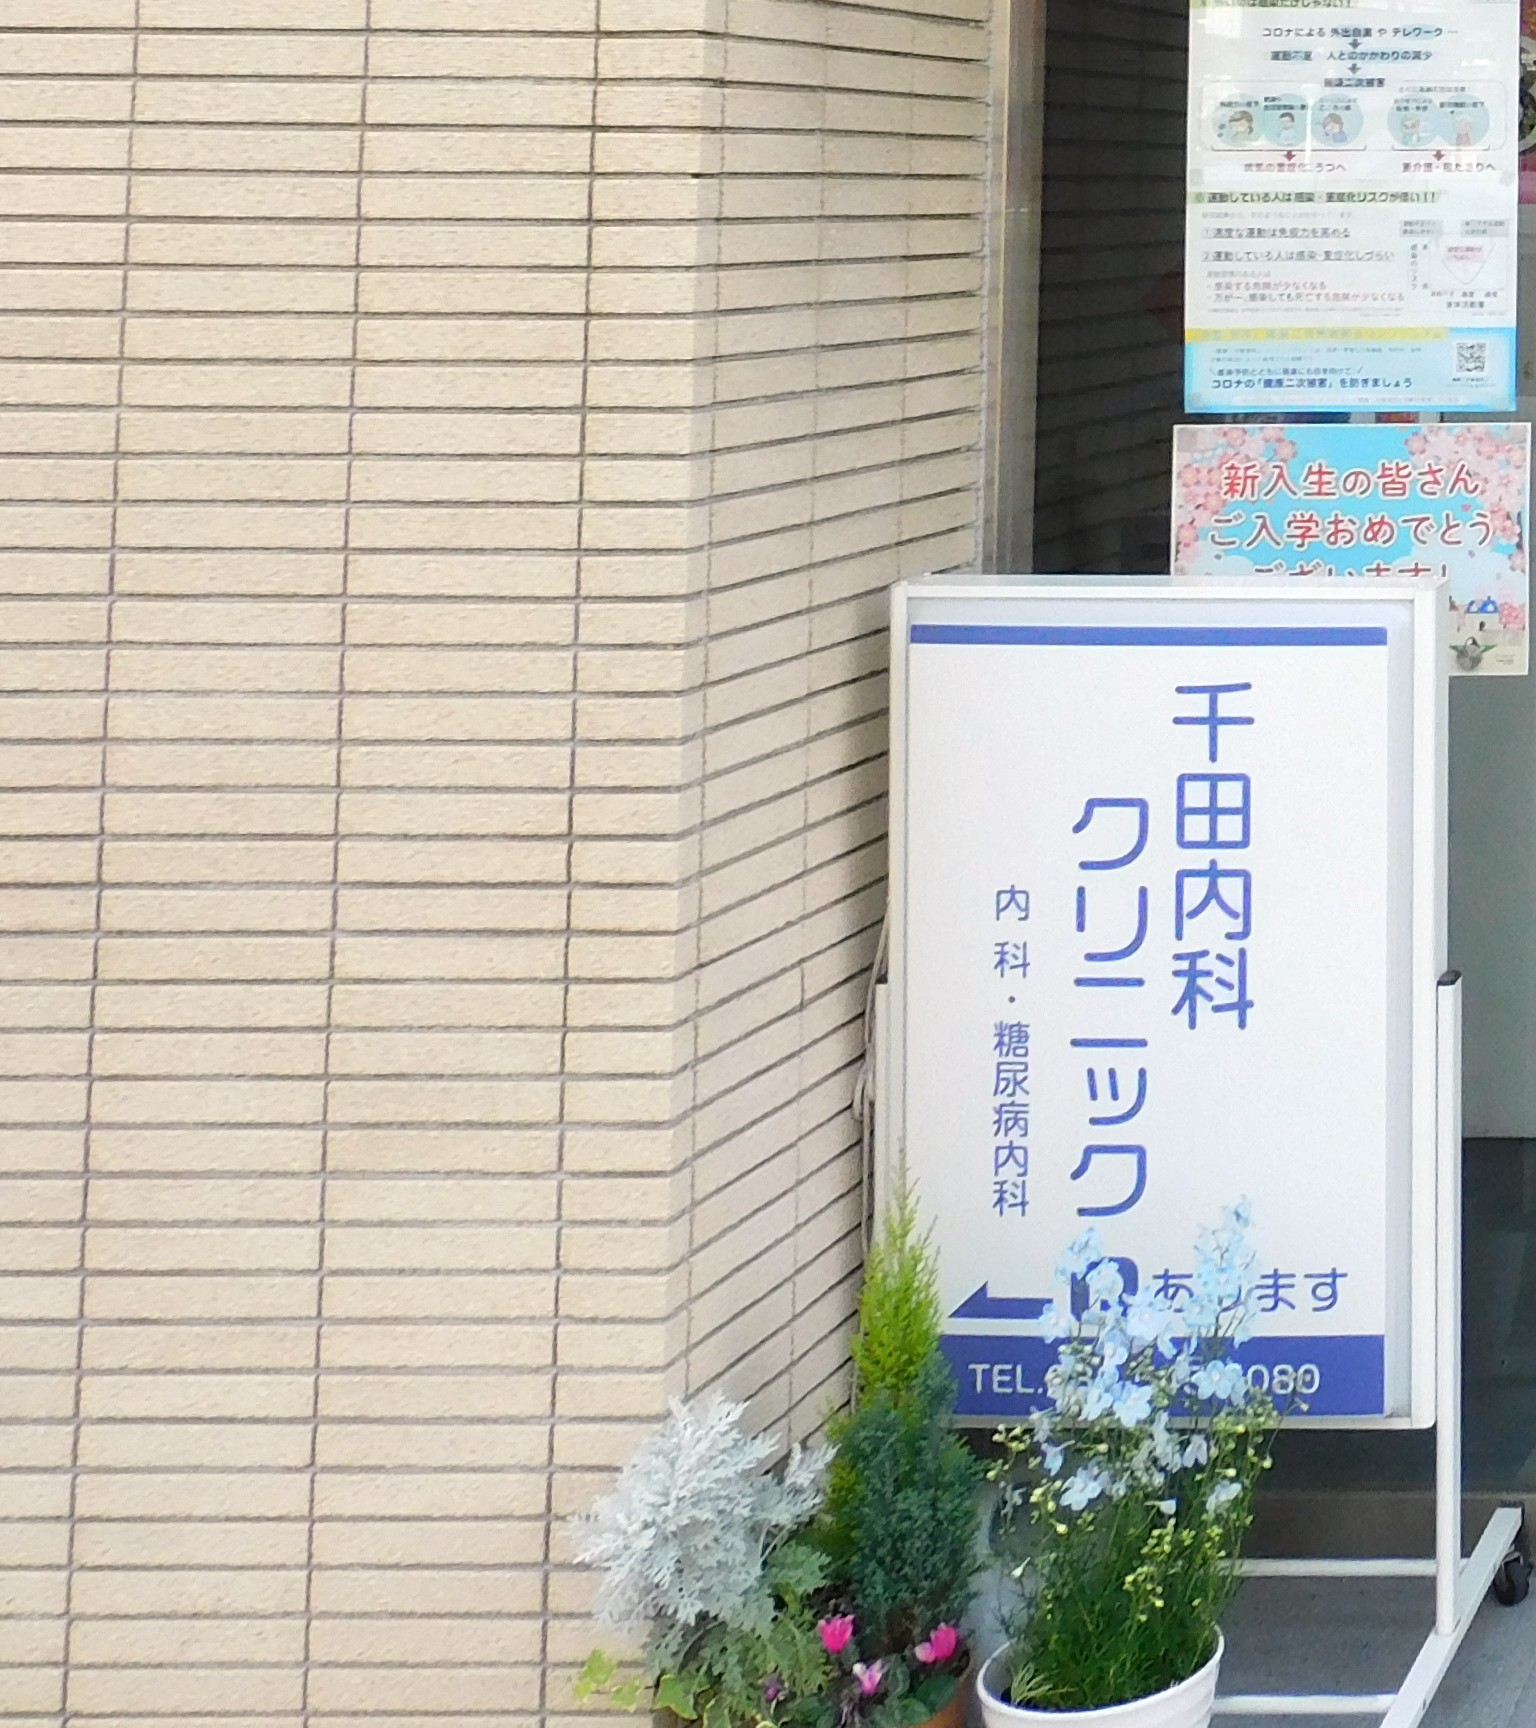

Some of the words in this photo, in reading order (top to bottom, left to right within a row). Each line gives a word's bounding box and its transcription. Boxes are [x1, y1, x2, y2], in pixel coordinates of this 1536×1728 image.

[1210, 512, 1493, 549] ご入学おめでとう
[1223, 462, 1481, 499] 新入生の皆さん
[1070, 798, 1148, 1217] クリニック
[1172, 682, 1254, 1030] 千田内科
[993, 884, 1030, 1217] 内科・糖尿病内科
